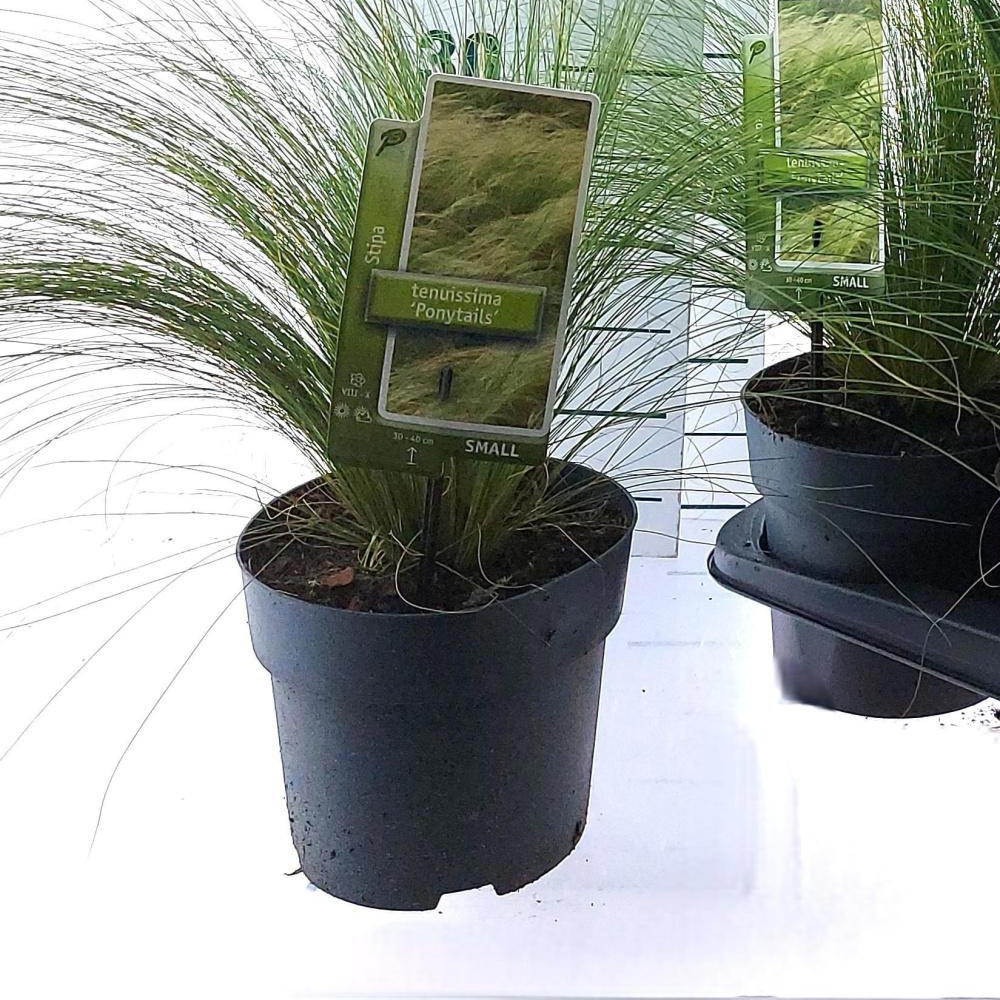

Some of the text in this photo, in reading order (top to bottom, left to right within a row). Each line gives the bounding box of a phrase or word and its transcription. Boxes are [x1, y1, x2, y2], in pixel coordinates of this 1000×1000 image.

[364, 225, 387, 265] Stipa
[833, 275, 869, 288] SMALL
[411, 283, 502, 306] tenuissima
[464, 439, 520, 458] SMALL
